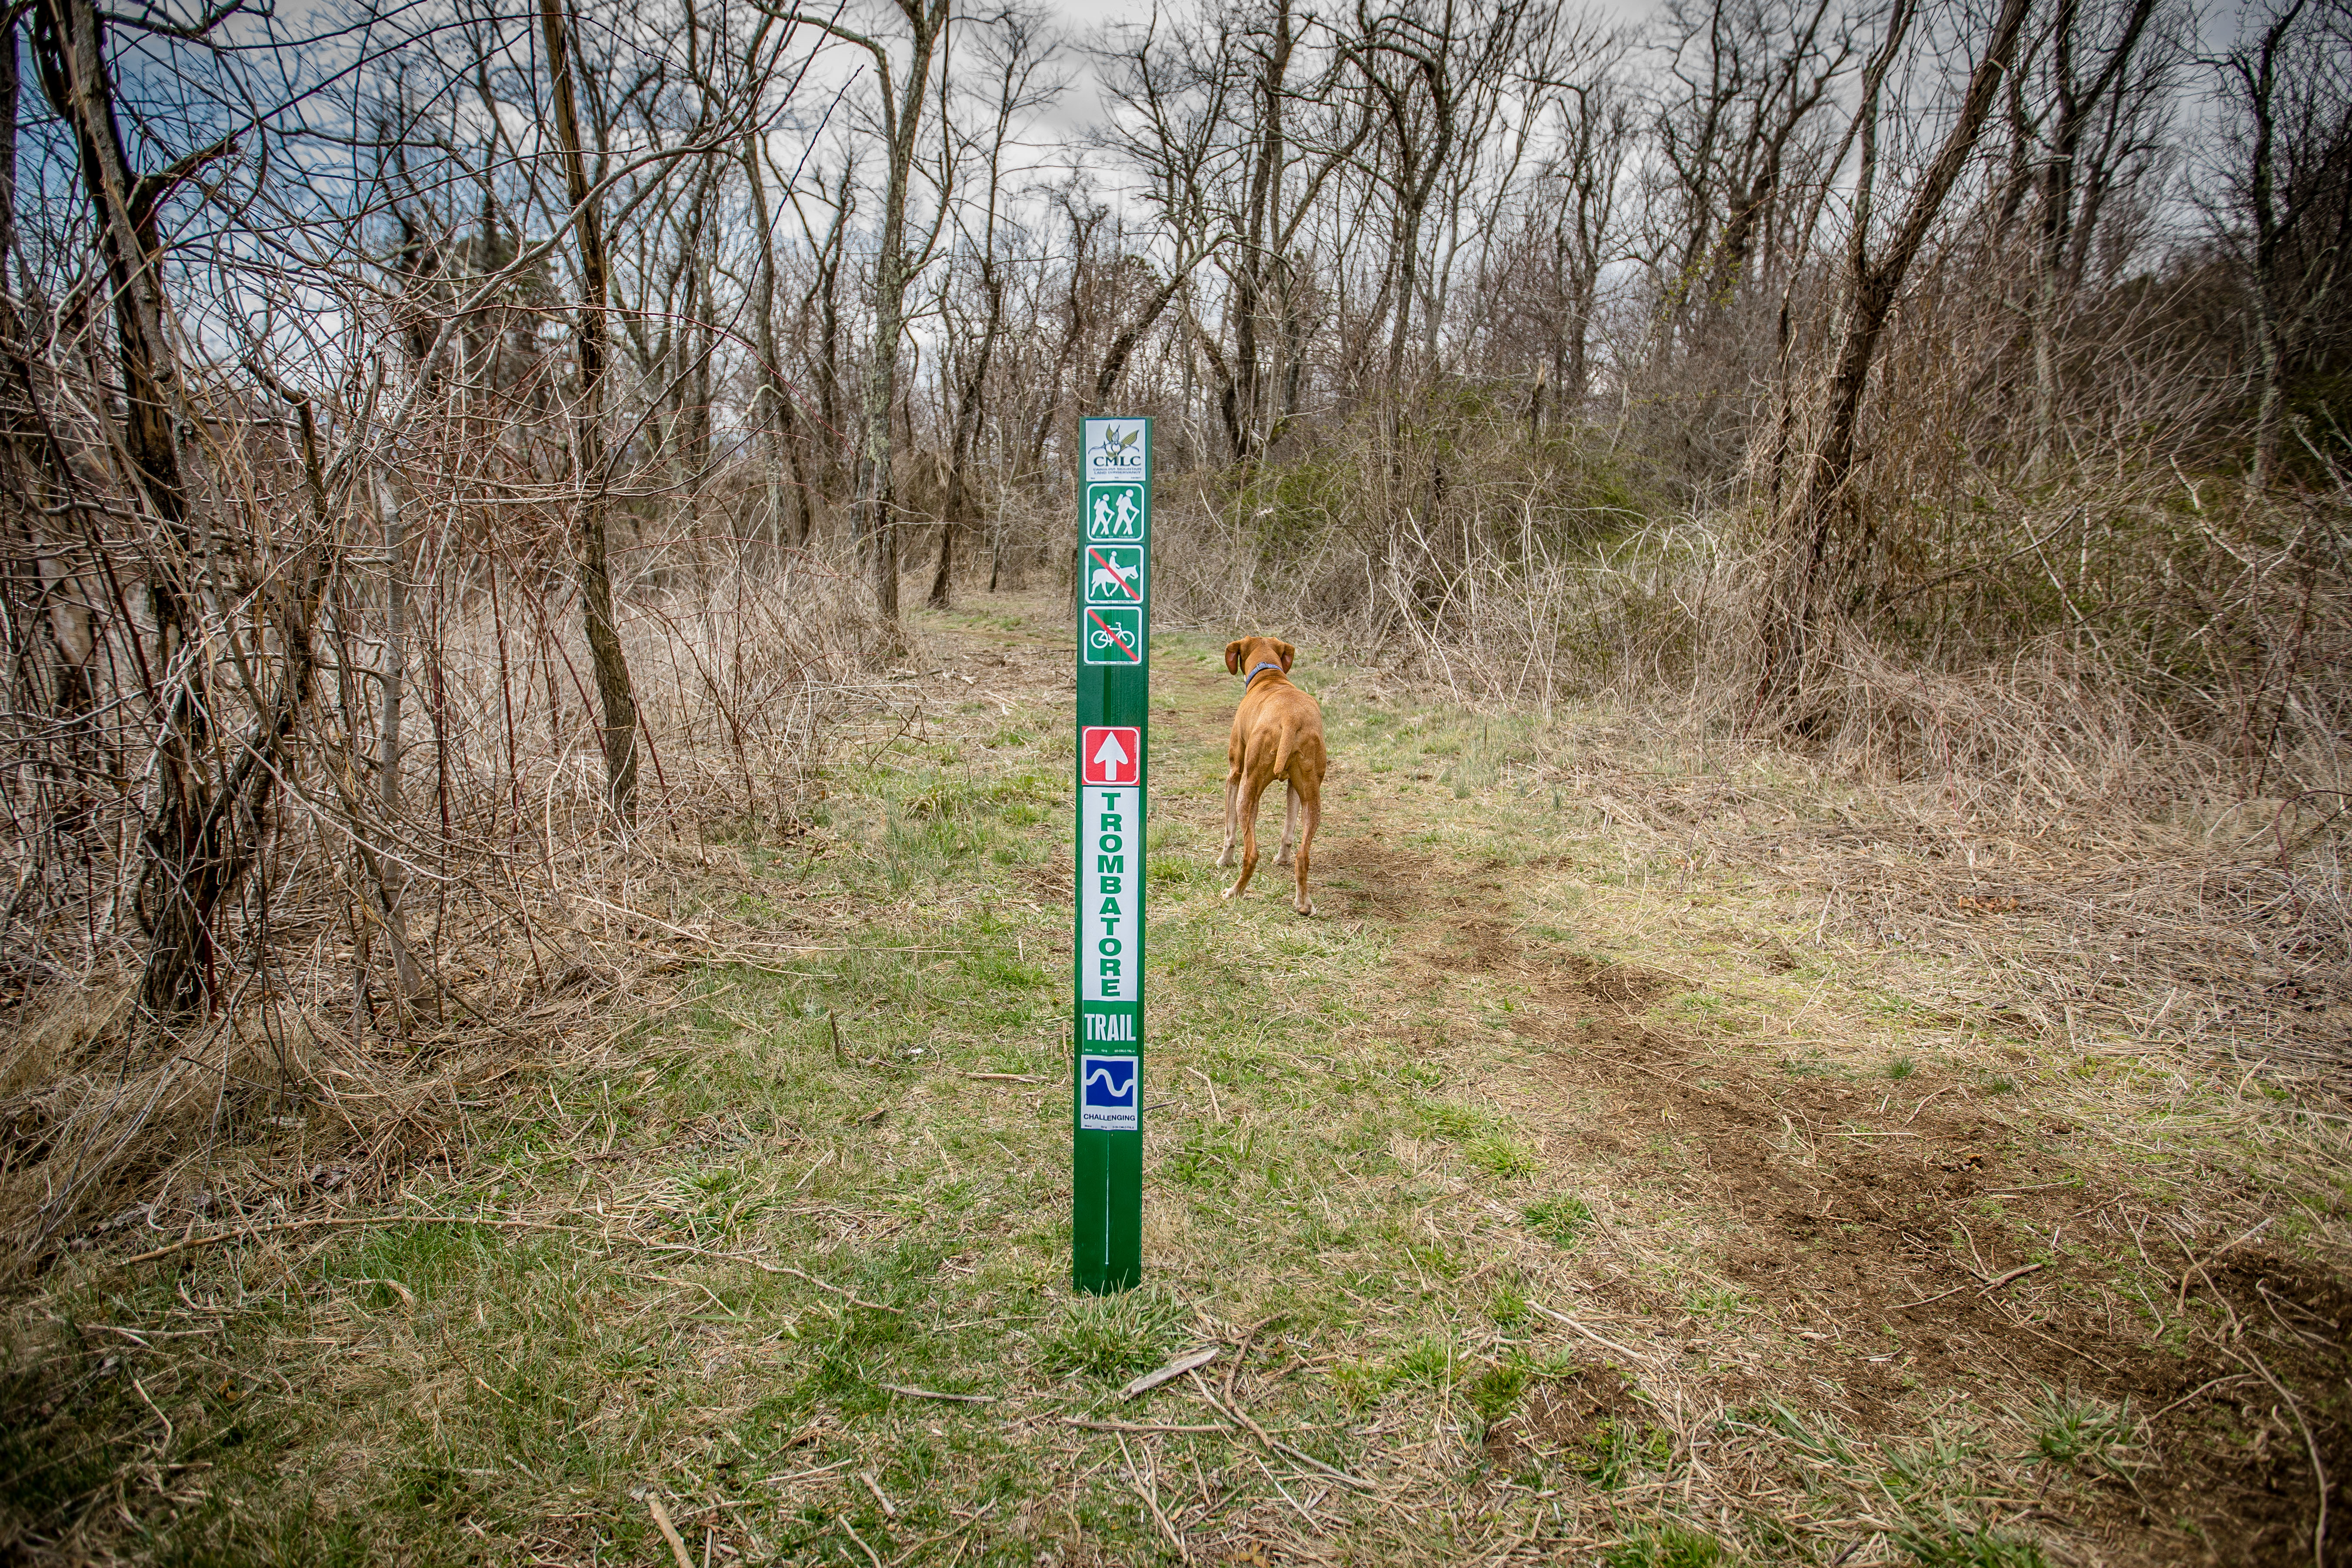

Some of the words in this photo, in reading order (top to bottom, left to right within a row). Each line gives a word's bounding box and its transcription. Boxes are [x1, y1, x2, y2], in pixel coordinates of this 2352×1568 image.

[1094, 456, 1141, 466] CMLC
[1097, 792, 1124, 996] TROMBATORE
[1084, 1013, 1136, 1041] TRAIL
